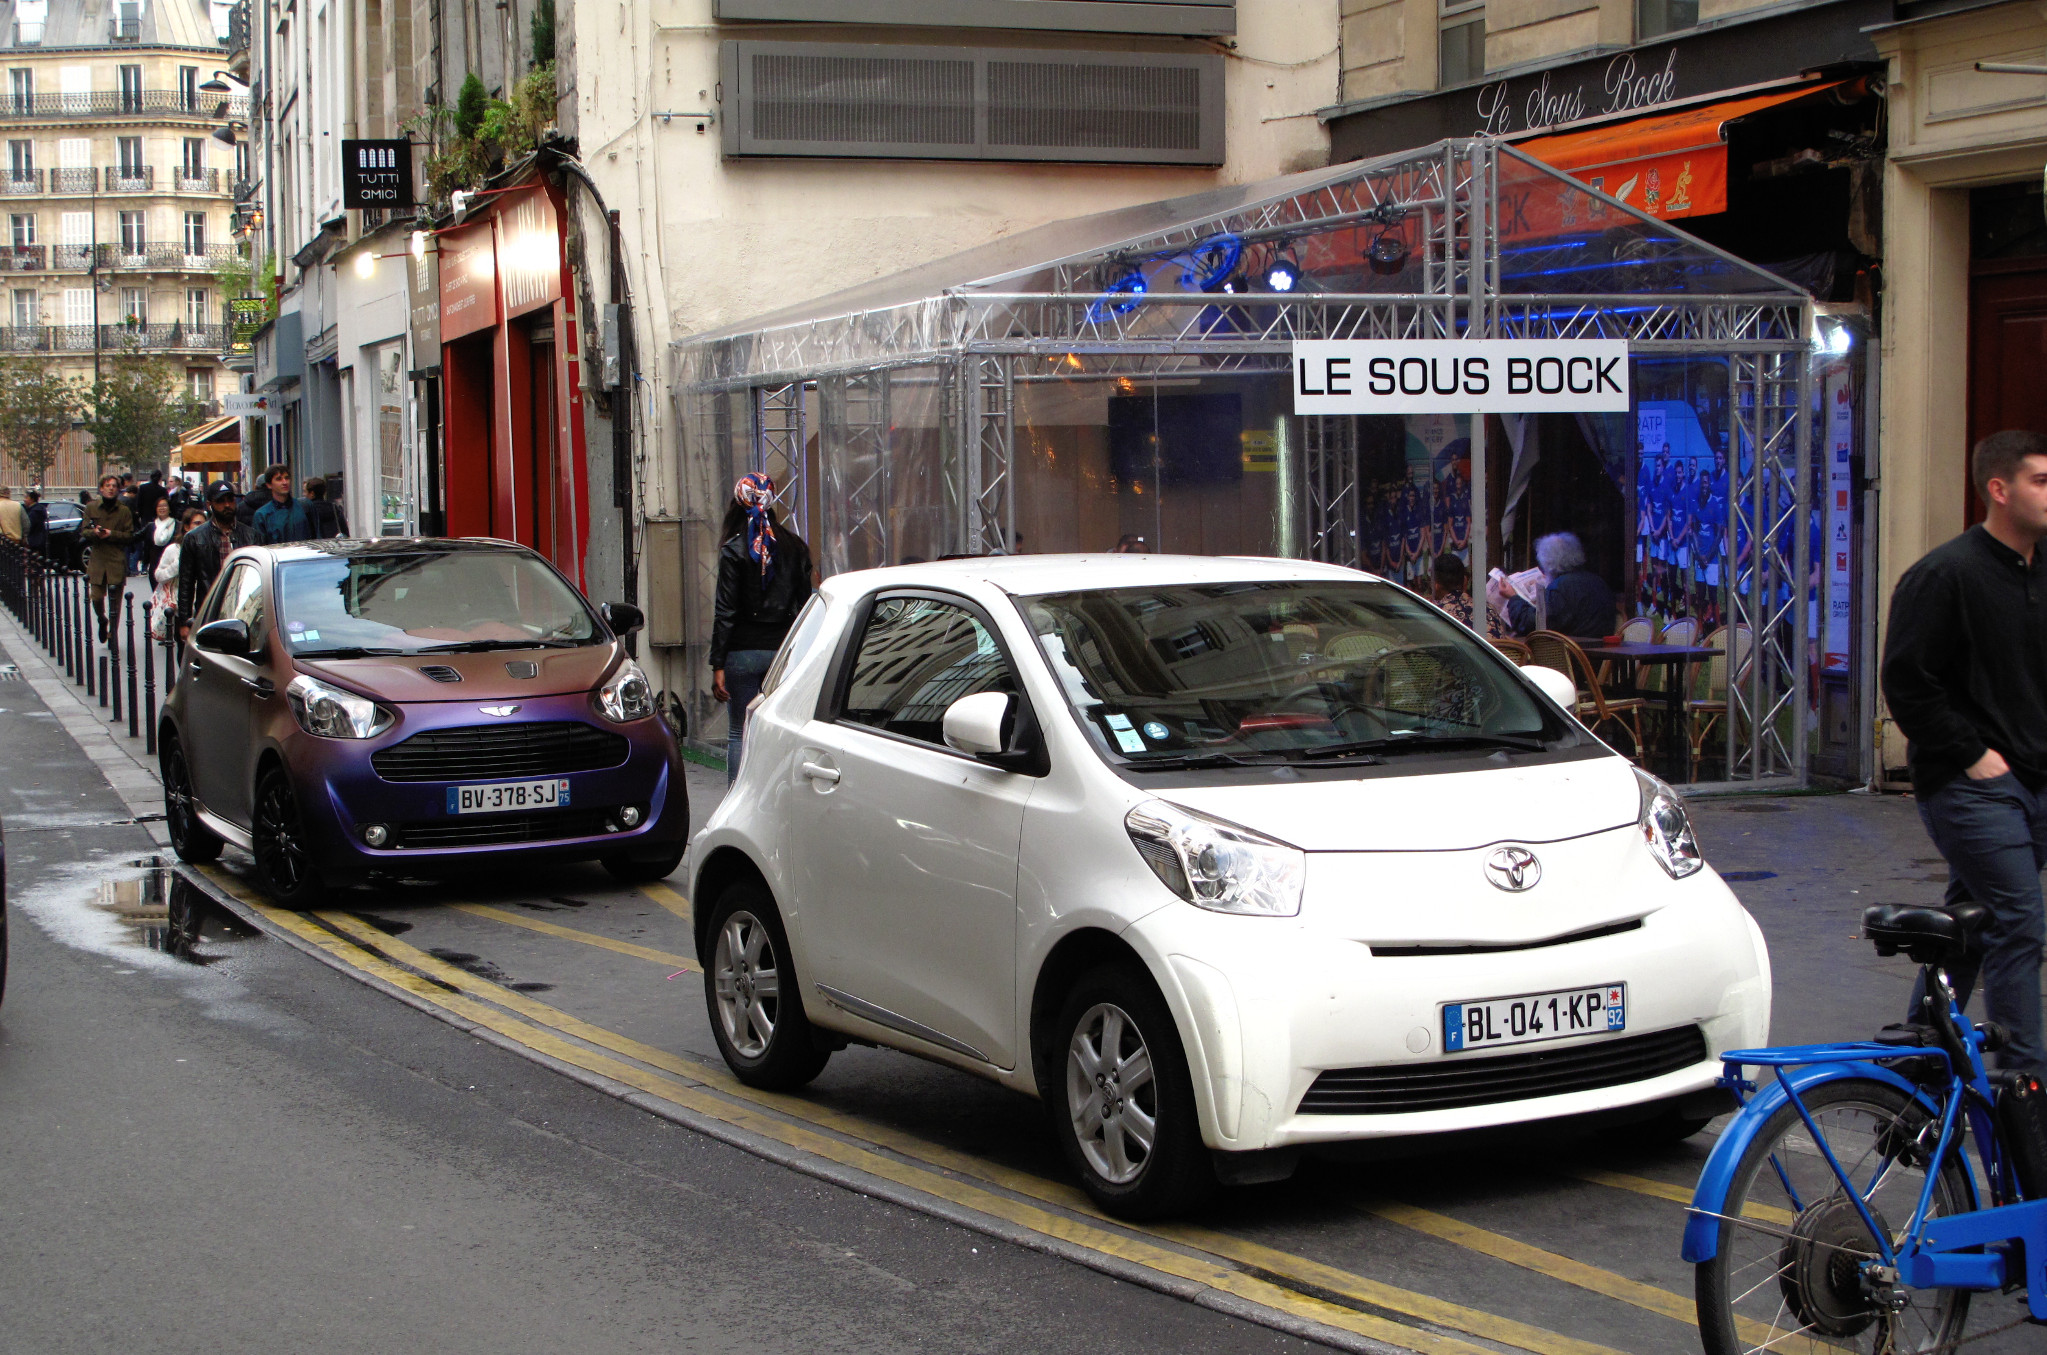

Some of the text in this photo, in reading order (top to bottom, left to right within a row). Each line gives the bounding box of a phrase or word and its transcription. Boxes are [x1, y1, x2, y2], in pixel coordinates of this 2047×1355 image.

[1473, 47, 1677, 138] Le Sous Bock
[1299, 356, 1623, 396] LE SOUS BOCK
[1832, 600, 1850, 610] RATP
[462, 783, 556, 809] BV-378-SJ
[559, 793, 570, 803] 75
[1467, 992, 1601, 1042] BL-041-KP
[1608, 1008, 1623, 1026] 92
[1451, 1031, 1457, 1042] F
